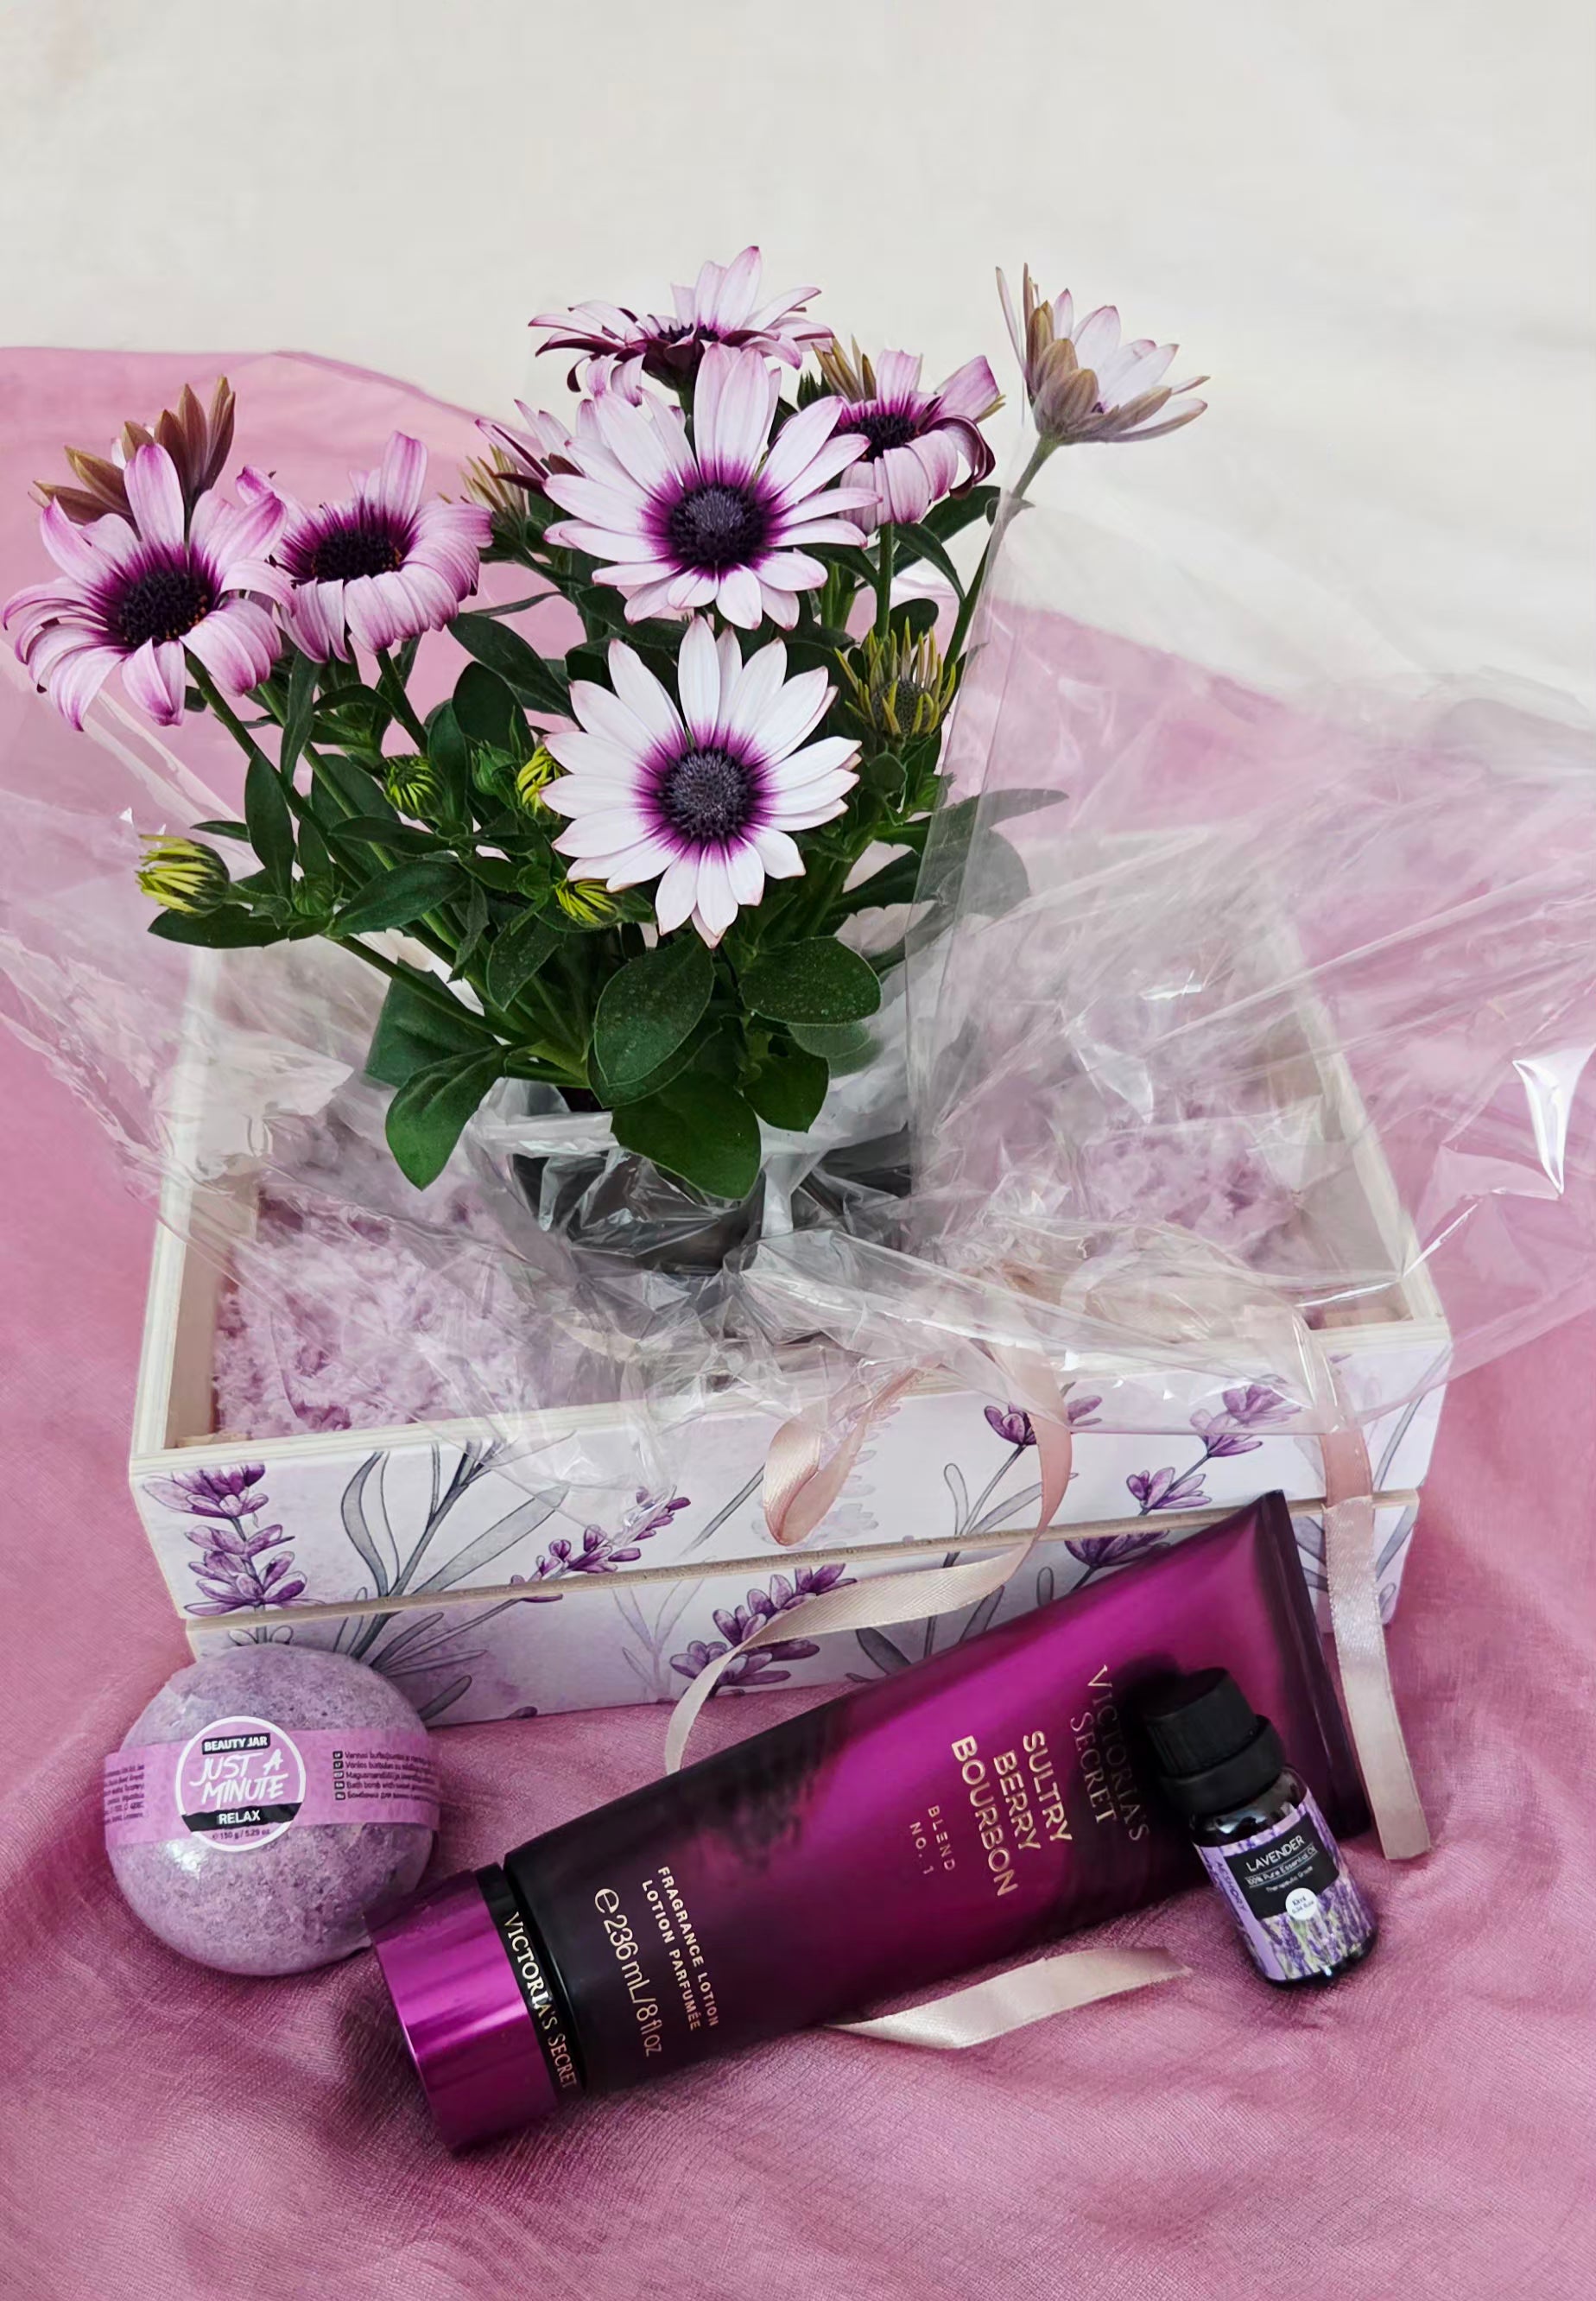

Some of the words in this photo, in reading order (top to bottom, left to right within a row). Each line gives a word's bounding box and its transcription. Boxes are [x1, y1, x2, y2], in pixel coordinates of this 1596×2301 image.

[189, 1752, 264, 1786] JUST
[263, 1748, 284, 1775] A
[201, 1773, 288, 1810] MINUTE
[204, 1738, 246, 1752] BEAUTY
[246, 1736, 268, 1747] JAR
[1023, 1730, 1073, 1841] SULTRY
[1070, 1711, 1117, 1823] SECRET
[218, 1810, 261, 1825] RELAX
[928, 1804, 956, 1871] BLEND
[951, 1734, 1018, 1896] BOURBON
[993, 1749, 1042, 1849] BERRY
[1246, 1835, 1306, 1873] LAVENDER
[642, 1879, 675, 1943] LOTION
[668, 1949, 701, 2031] PARFUMÉE
[657, 1866, 704, 1968] FRAGRANCE
[697, 1972, 719, 2026] LOTION
[504, 1911, 558, 2032] VICTORIA'S
[547, 2032, 577, 2089] SECRET
